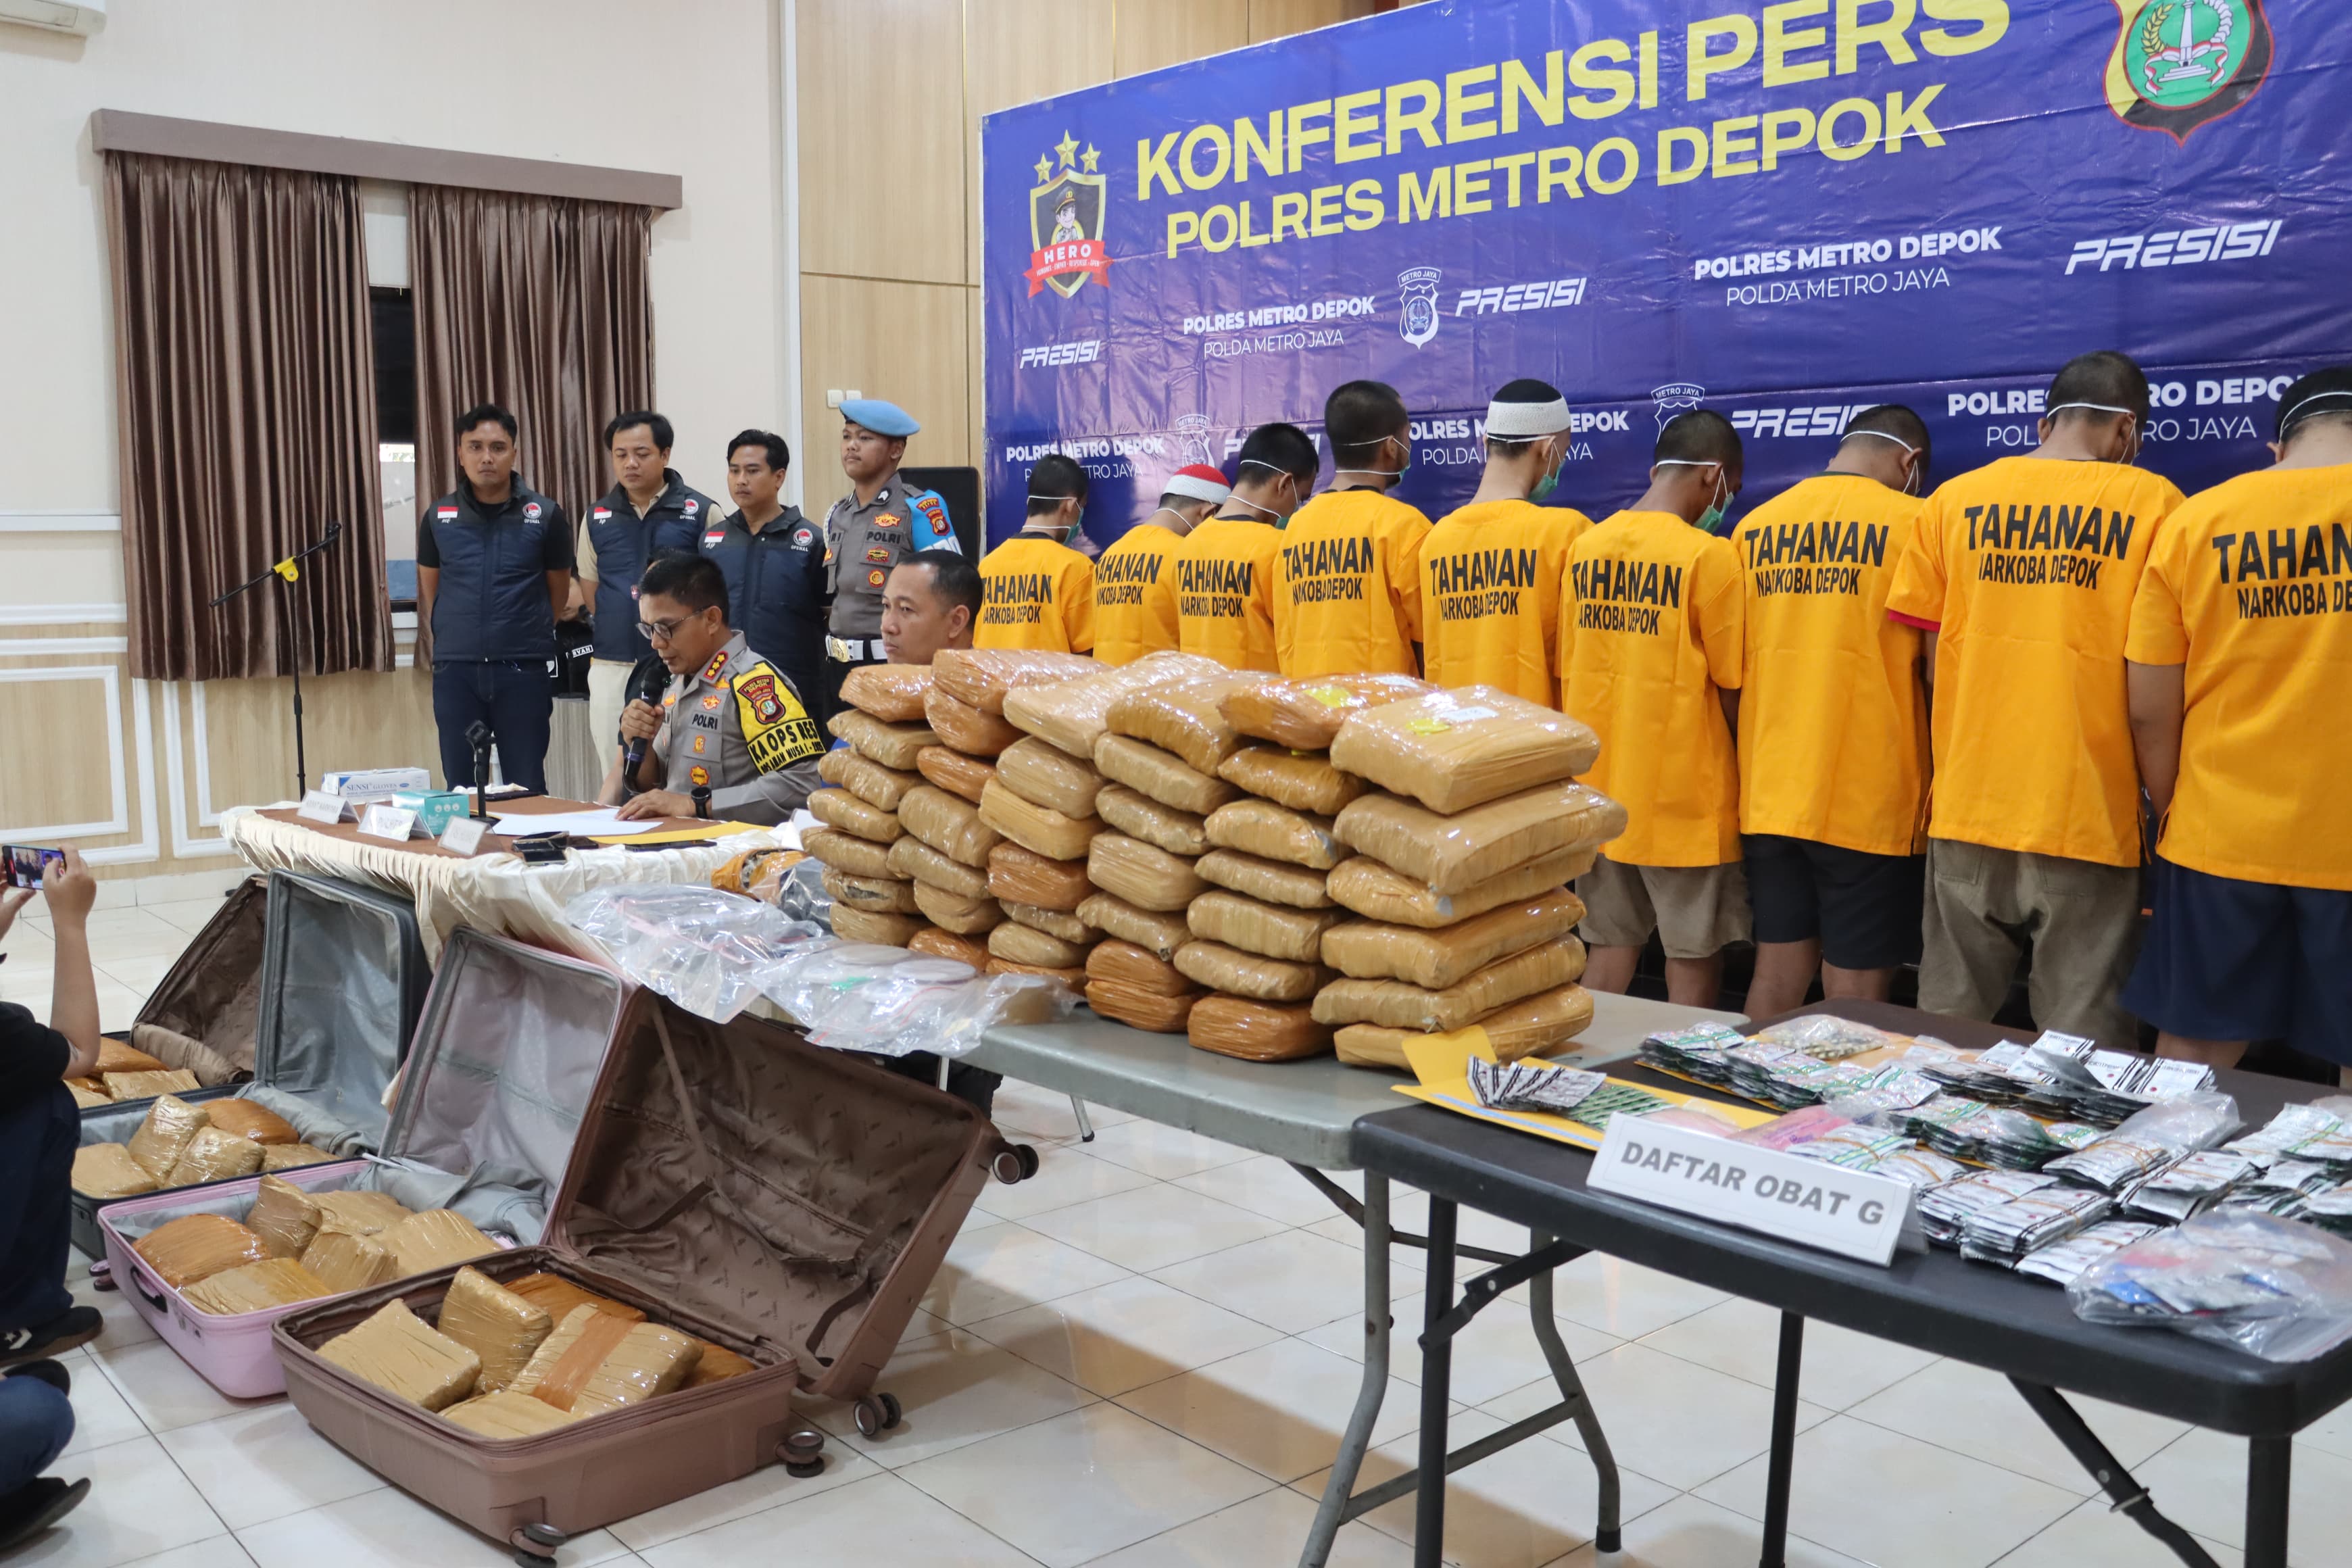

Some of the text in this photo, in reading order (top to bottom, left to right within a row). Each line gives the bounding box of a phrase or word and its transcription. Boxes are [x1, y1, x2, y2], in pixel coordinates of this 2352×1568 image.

[1136, 0, 2010, 201] KONFERENSI PERS
[1167, 84, 1949, 259] POLRES METRO DEPOK
[1044, 243, 1092, 264] HERO
[1694, 226, 2002, 280] POLRES METRO DEPOK
[2065, 220, 2282, 275] PRESISI
[1401, 270, 1438, 283] METRO JAYA
[1727, 267, 1951, 307] POLDA METRO JAYA
[1455, 277, 1587, 316] PRESISI
[1183, 296, 1375, 335] POLRES METRO DEPOK
[1019, 341, 1100, 369] PRESISI
[1204, 329, 1344, 359] POLDA METRO JAYA
[1656, 387, 1700, 399] METRO JAYA
[1948, 389, 2050, 416] POLRE
[2196, 375, 2305, 406] DEPO
[1408, 420, 1470, 441] OLRES
[1570, 410, 1630, 433] EPOK
[1731, 404, 1880, 438] PRESI
[1987, 425, 2042, 447] POL
[2186, 416, 2257, 441] JAYA
[1006, 437, 1166, 462] POLRES METRO DEPOK
[1422, 443, 1593, 465] POLDA YA
[1080, 463, 1143, 480] TRO JAYA
[866, 531, 901, 544] POLRI
[1745, 521, 1889, 570] TAHANAN
[1965, 504, 2136, 560] TAHANAN
[1283, 537, 1373, 582] TAHANAN
[2212, 522, 2352, 584] TAHAN
[1096, 554, 1163, 585] TAHANAN
[1177, 559, 1252, 596] TAHANAN
[1430, 548, 1537, 596] TAHANAN
[1571, 559, 1682, 608] TAHANAN
[1815, 567, 1862, 595] DEPOK
[2050, 555, 2103, 590] DEPOK
[982, 574, 1052, 606] TAHANAN
[1117, 585, 1144, 605] DEPOK
[1292, 577, 1363, 606] NKOBA DEPOK
[1485, 591, 1519, 616] DEPOK
[2237, 583, 2328, 619] NARKOBA
[984, 605, 1041, 624] ARKOBA DEPOK
[1212, 596, 1244, 618] DEPOK
[1579, 604, 1661, 636] ARKOBA DEPOK
[692, 714, 718, 730] POLRI
[750, 720, 818, 764] KA OPS RES
[1621, 1141, 1884, 1225] DAFTAR OBAT G
